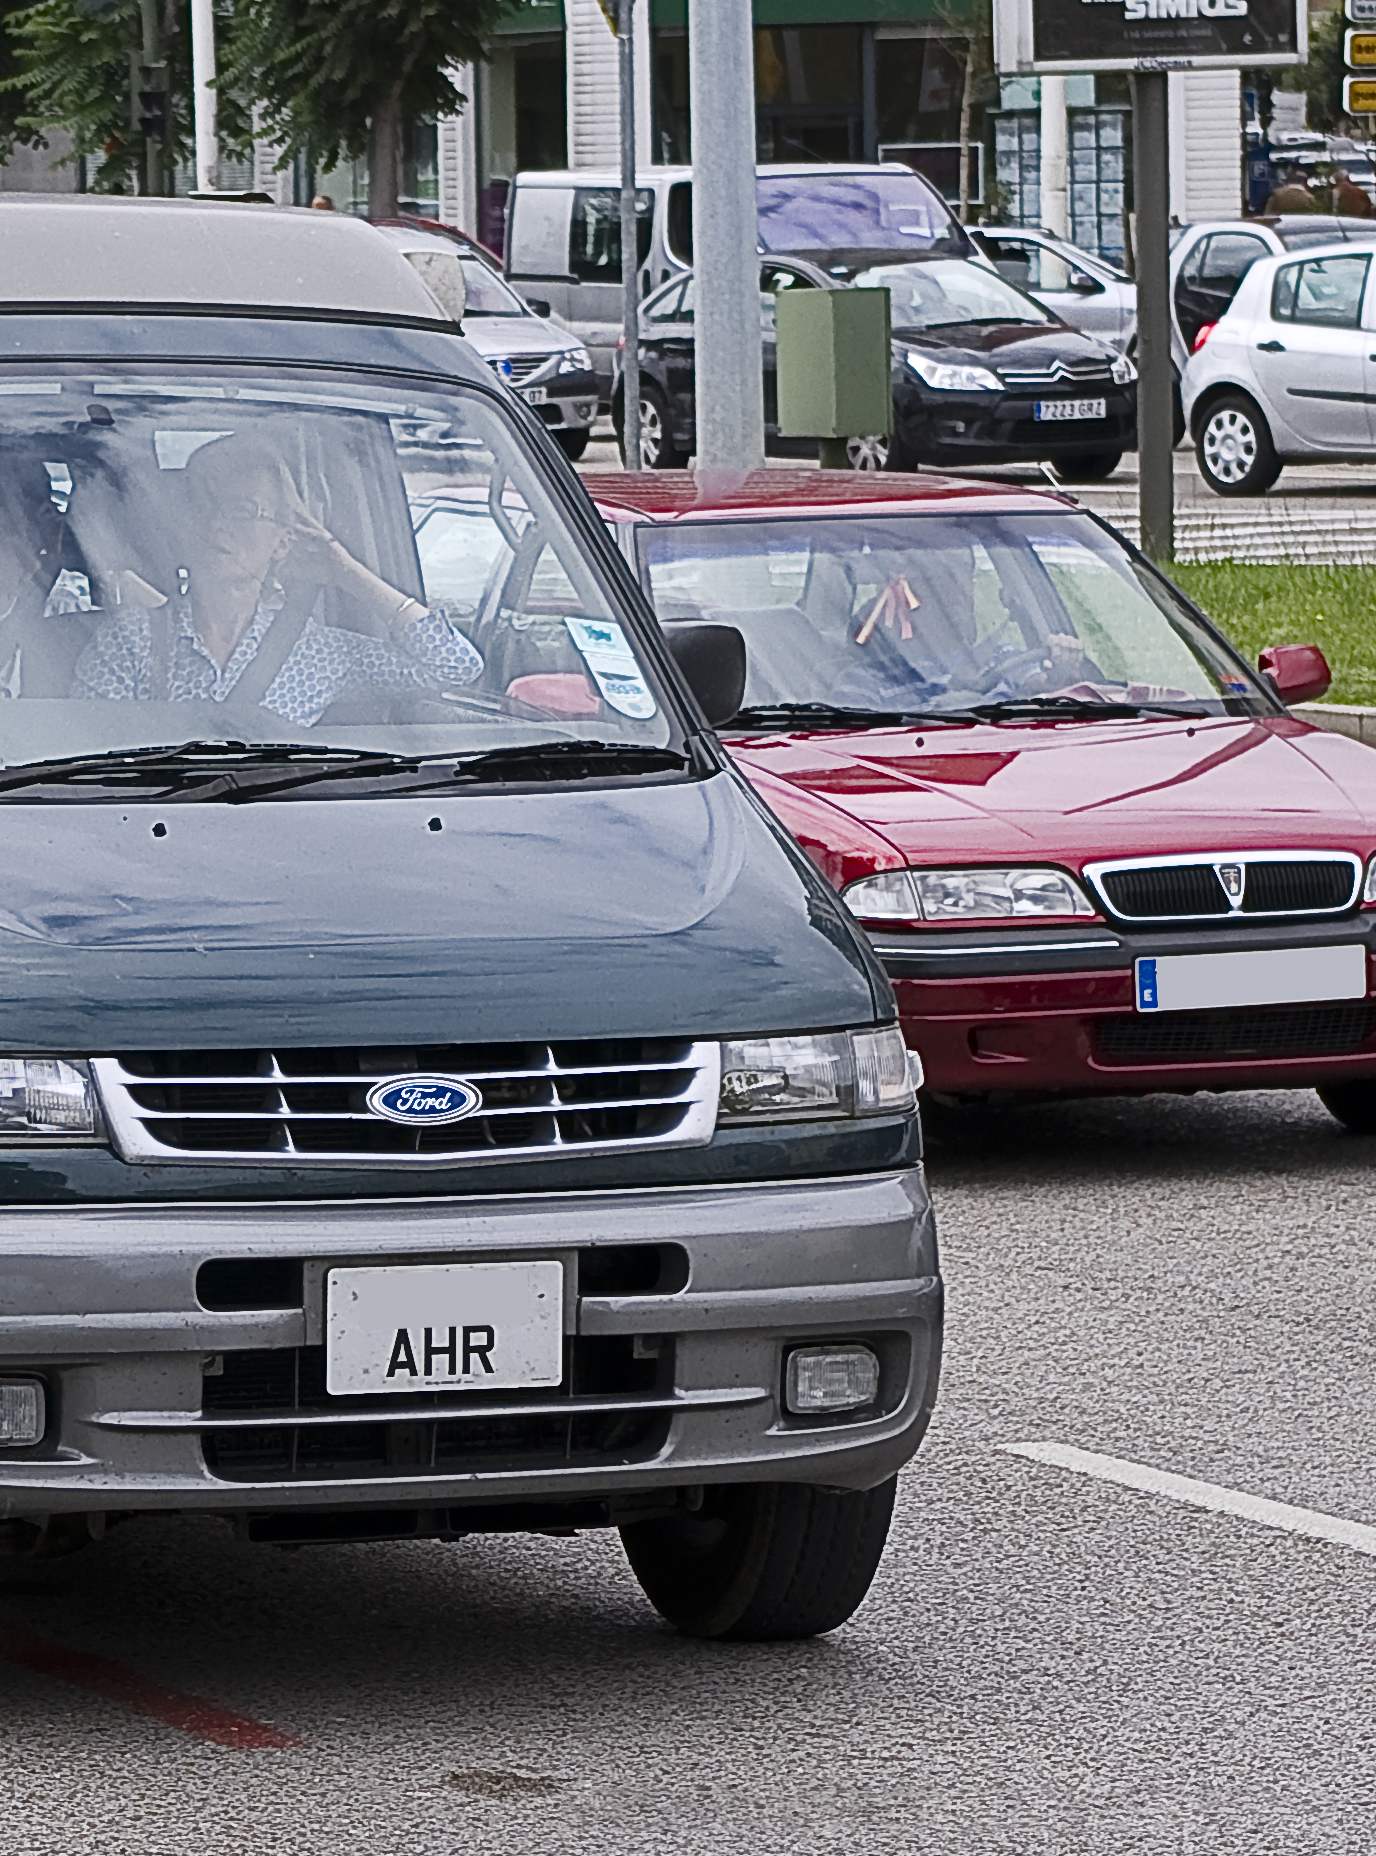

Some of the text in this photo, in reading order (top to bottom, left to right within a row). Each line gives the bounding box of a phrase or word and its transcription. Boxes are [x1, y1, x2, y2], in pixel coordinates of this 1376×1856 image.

[1044, 403, 1075, 418] 7223
[1143, 988, 1153, 1002] E
[396, 1087, 452, 1111] Ford
[385, 1324, 496, 1378] AHR
